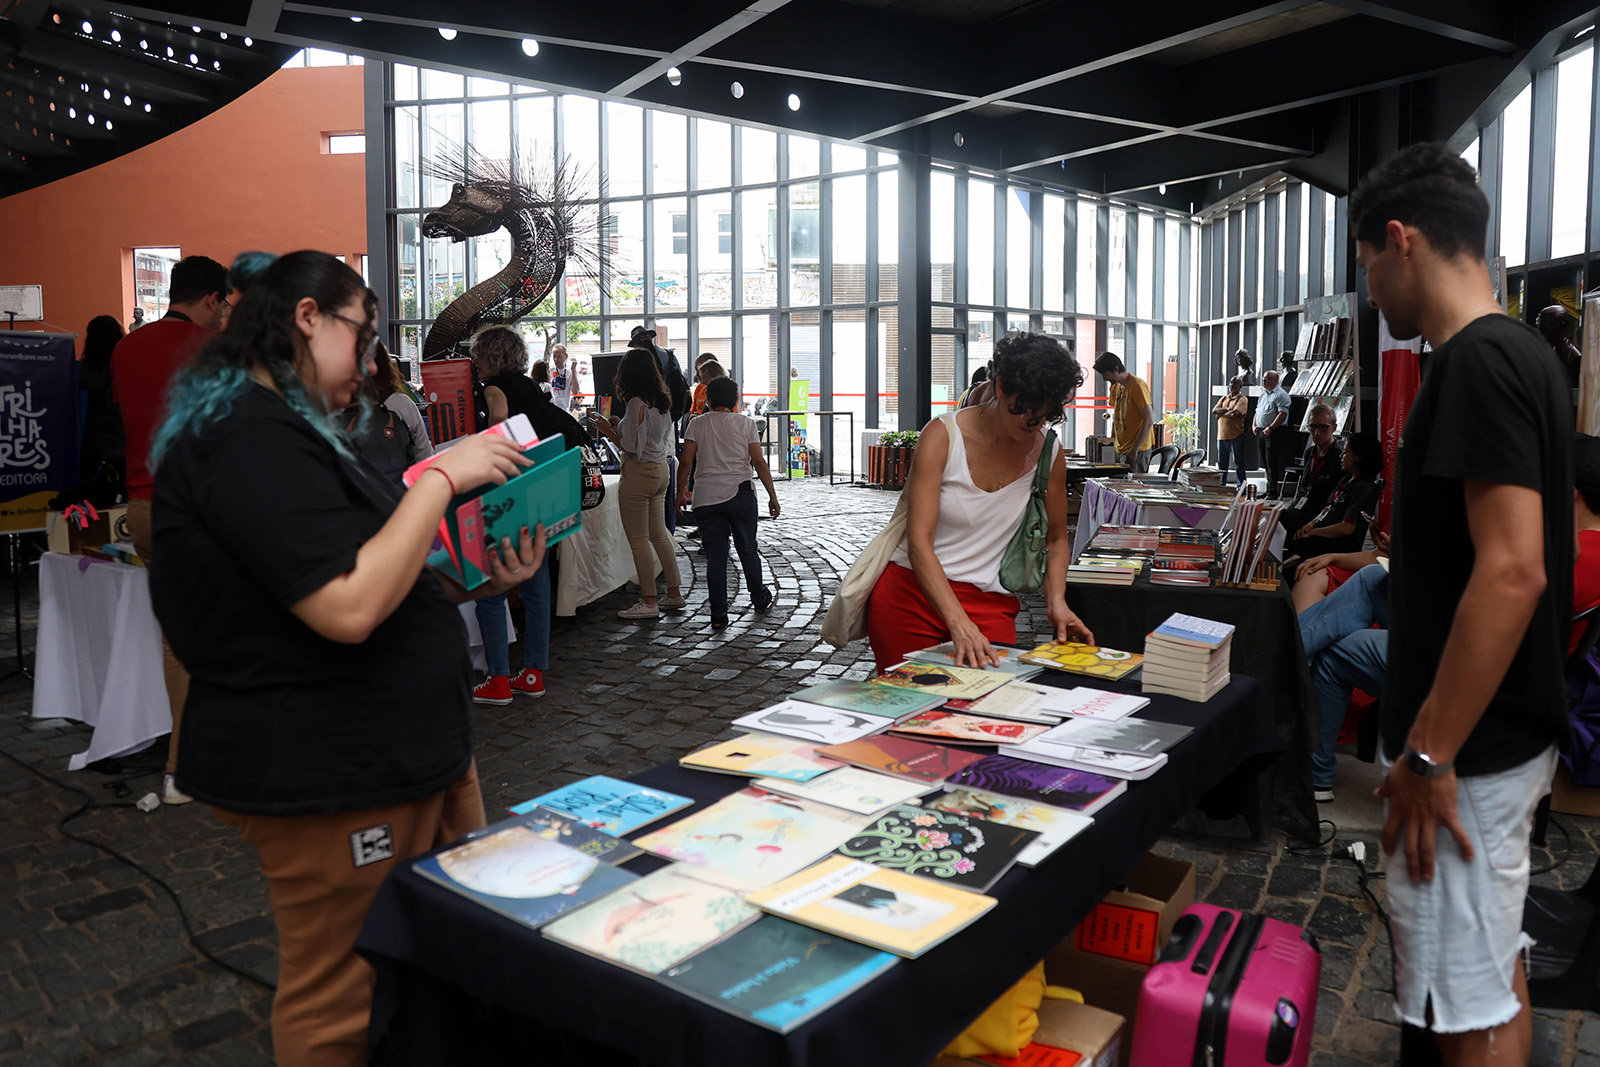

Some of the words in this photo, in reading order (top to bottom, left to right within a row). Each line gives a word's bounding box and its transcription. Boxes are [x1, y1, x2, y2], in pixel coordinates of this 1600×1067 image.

[410, 330, 418, 369] CURITIBA
[456, 389, 466, 433] Editora
[0, 472, 48, 486] EDITORA
